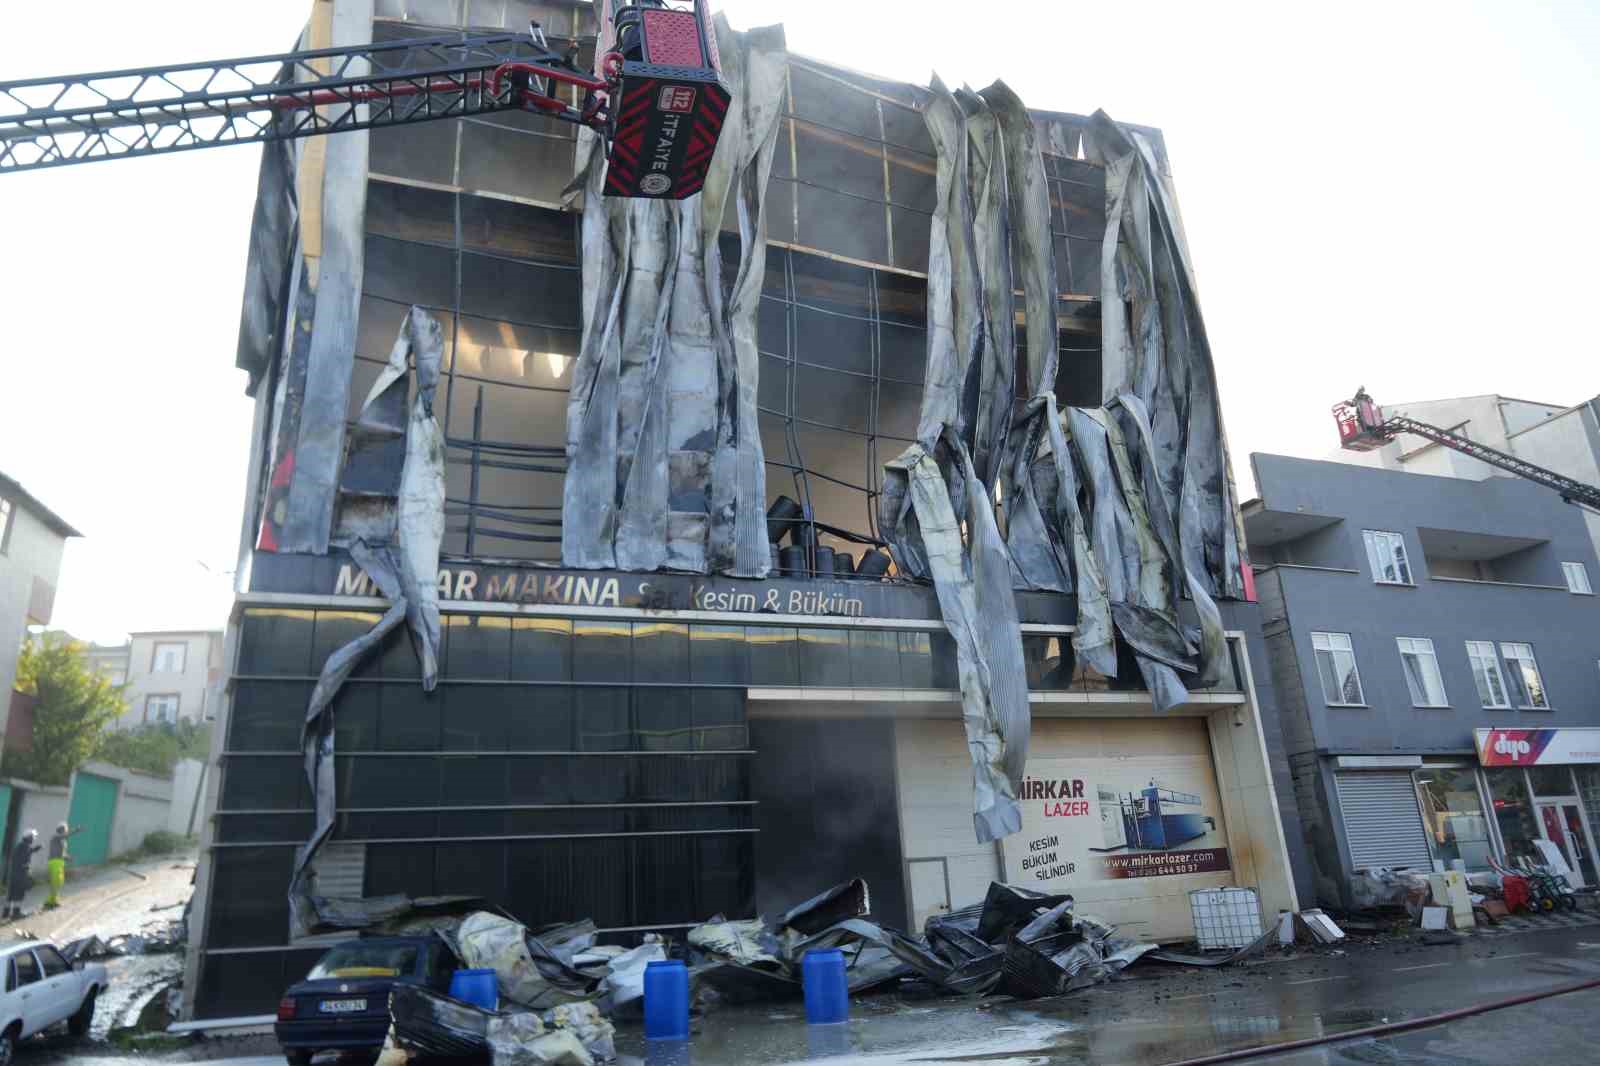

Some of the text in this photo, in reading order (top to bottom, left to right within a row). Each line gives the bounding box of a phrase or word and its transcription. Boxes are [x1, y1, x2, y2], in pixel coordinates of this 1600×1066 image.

[672, 91, 689, 108] 112
[690, 585, 756, 611] Kesim
[763, 588, 780, 610] &
[788, 589, 863, 616] Büküm
[1494, 733, 1530, 761] dyo
[1044, 801, 1089, 817] LAZER
[1029, 835, 1059, 852] KESİM
[1022, 850, 1058, 870] BÜKÜM
[1036, 862, 1076, 881] SİLİNDİR
